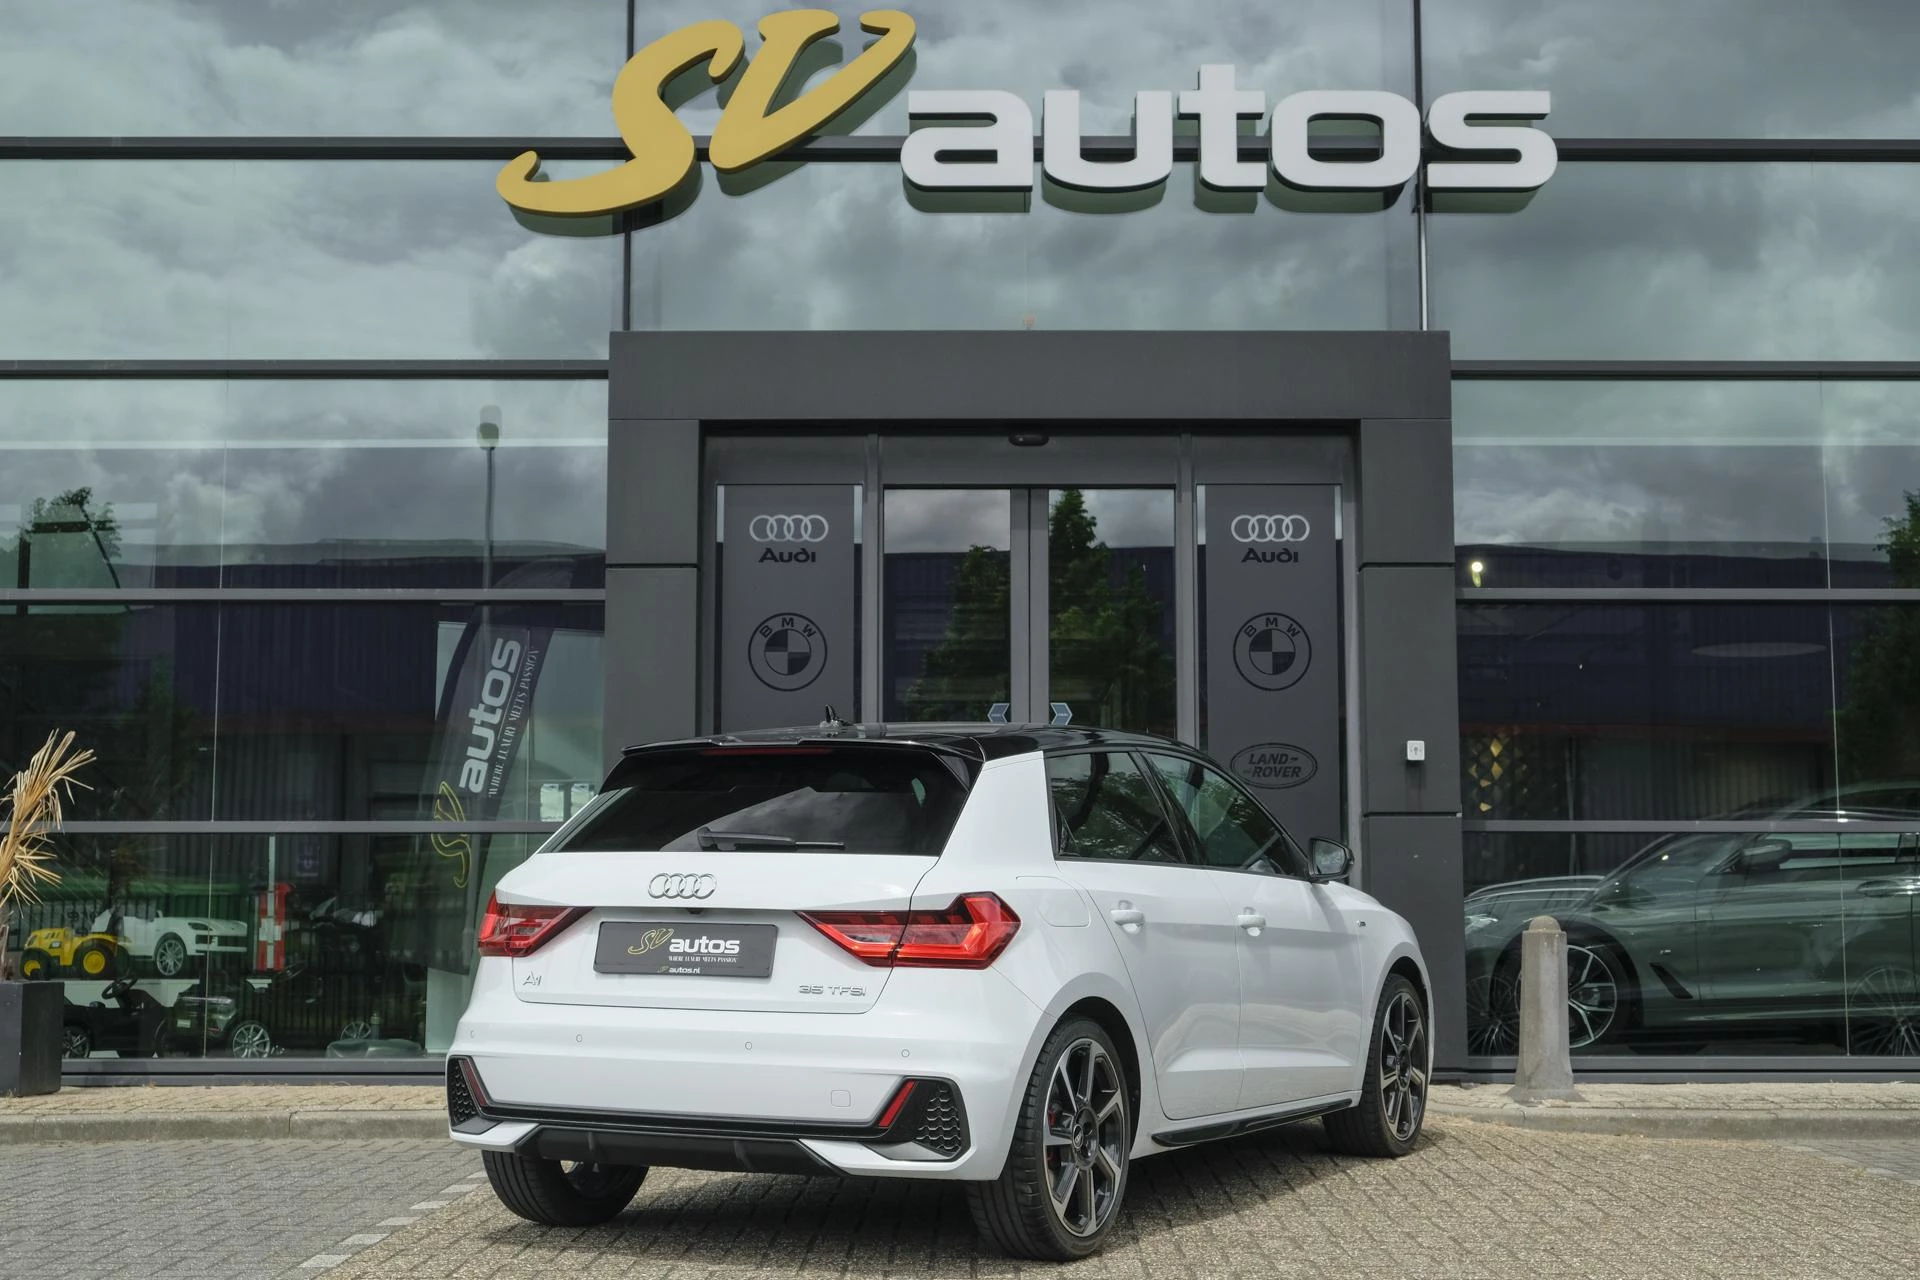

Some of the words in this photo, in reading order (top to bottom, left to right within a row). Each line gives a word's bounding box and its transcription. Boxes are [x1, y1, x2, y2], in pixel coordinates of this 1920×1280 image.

[496, 9, 917, 216] SV
[900, 64, 1557, 191] autos
[758, 547, 816, 563] Audi
[1241, 547, 1299, 563] Audi
[759, 617, 817, 638] BMW
[1244, 617, 1300, 638] BMW
[458, 638, 521, 794] autos
[668, 936, 741, 954] autos
[799, 984, 824, 995] 35
